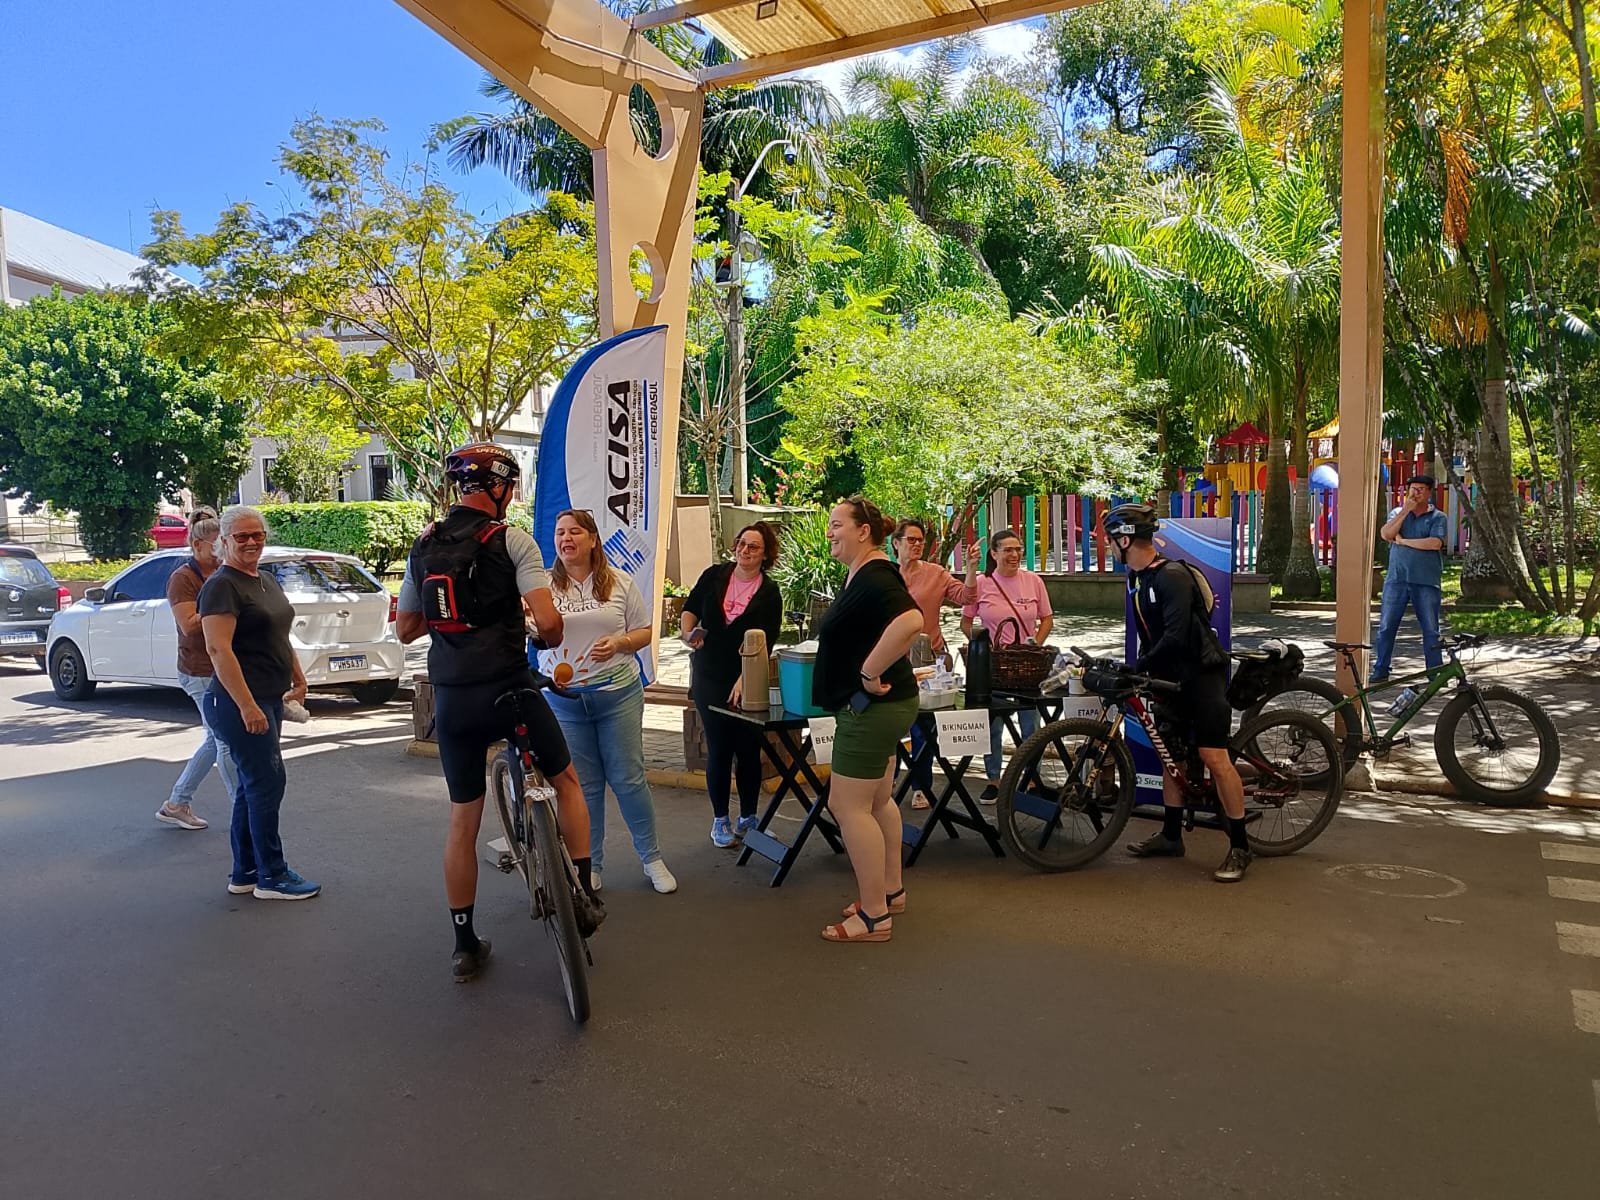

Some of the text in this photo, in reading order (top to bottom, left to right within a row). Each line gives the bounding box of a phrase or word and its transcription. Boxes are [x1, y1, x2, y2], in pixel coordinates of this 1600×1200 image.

[648, 381, 657, 441] FEDERASUL
[607, 380, 630, 527] ACISA
[633, 479, 638, 488] DO
[1078, 709, 1099, 717] ETAPA
[942, 722, 985, 731] BIKINGMAN
[952, 735, 977, 743] BRASIL
